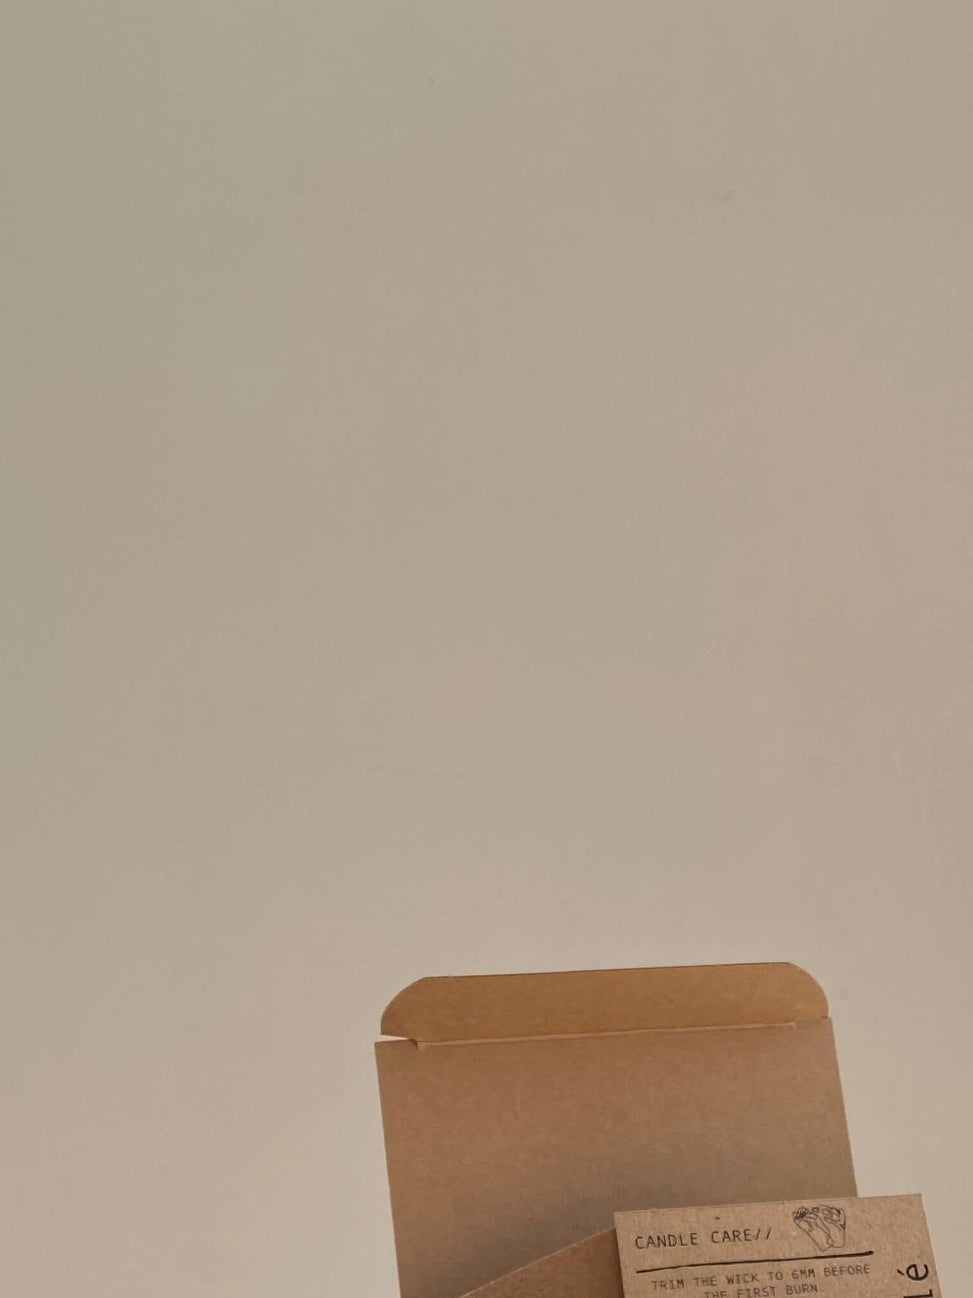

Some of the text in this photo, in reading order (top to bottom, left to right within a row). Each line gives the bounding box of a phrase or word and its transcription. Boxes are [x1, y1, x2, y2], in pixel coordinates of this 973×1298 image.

[635, 1227, 772, 1249] CANDLE CARE//
[651, 1264, 871, 1291] TRIM THE WICK TO 6MM BEFORE
[736, 1286, 776, 1298] FIRST
